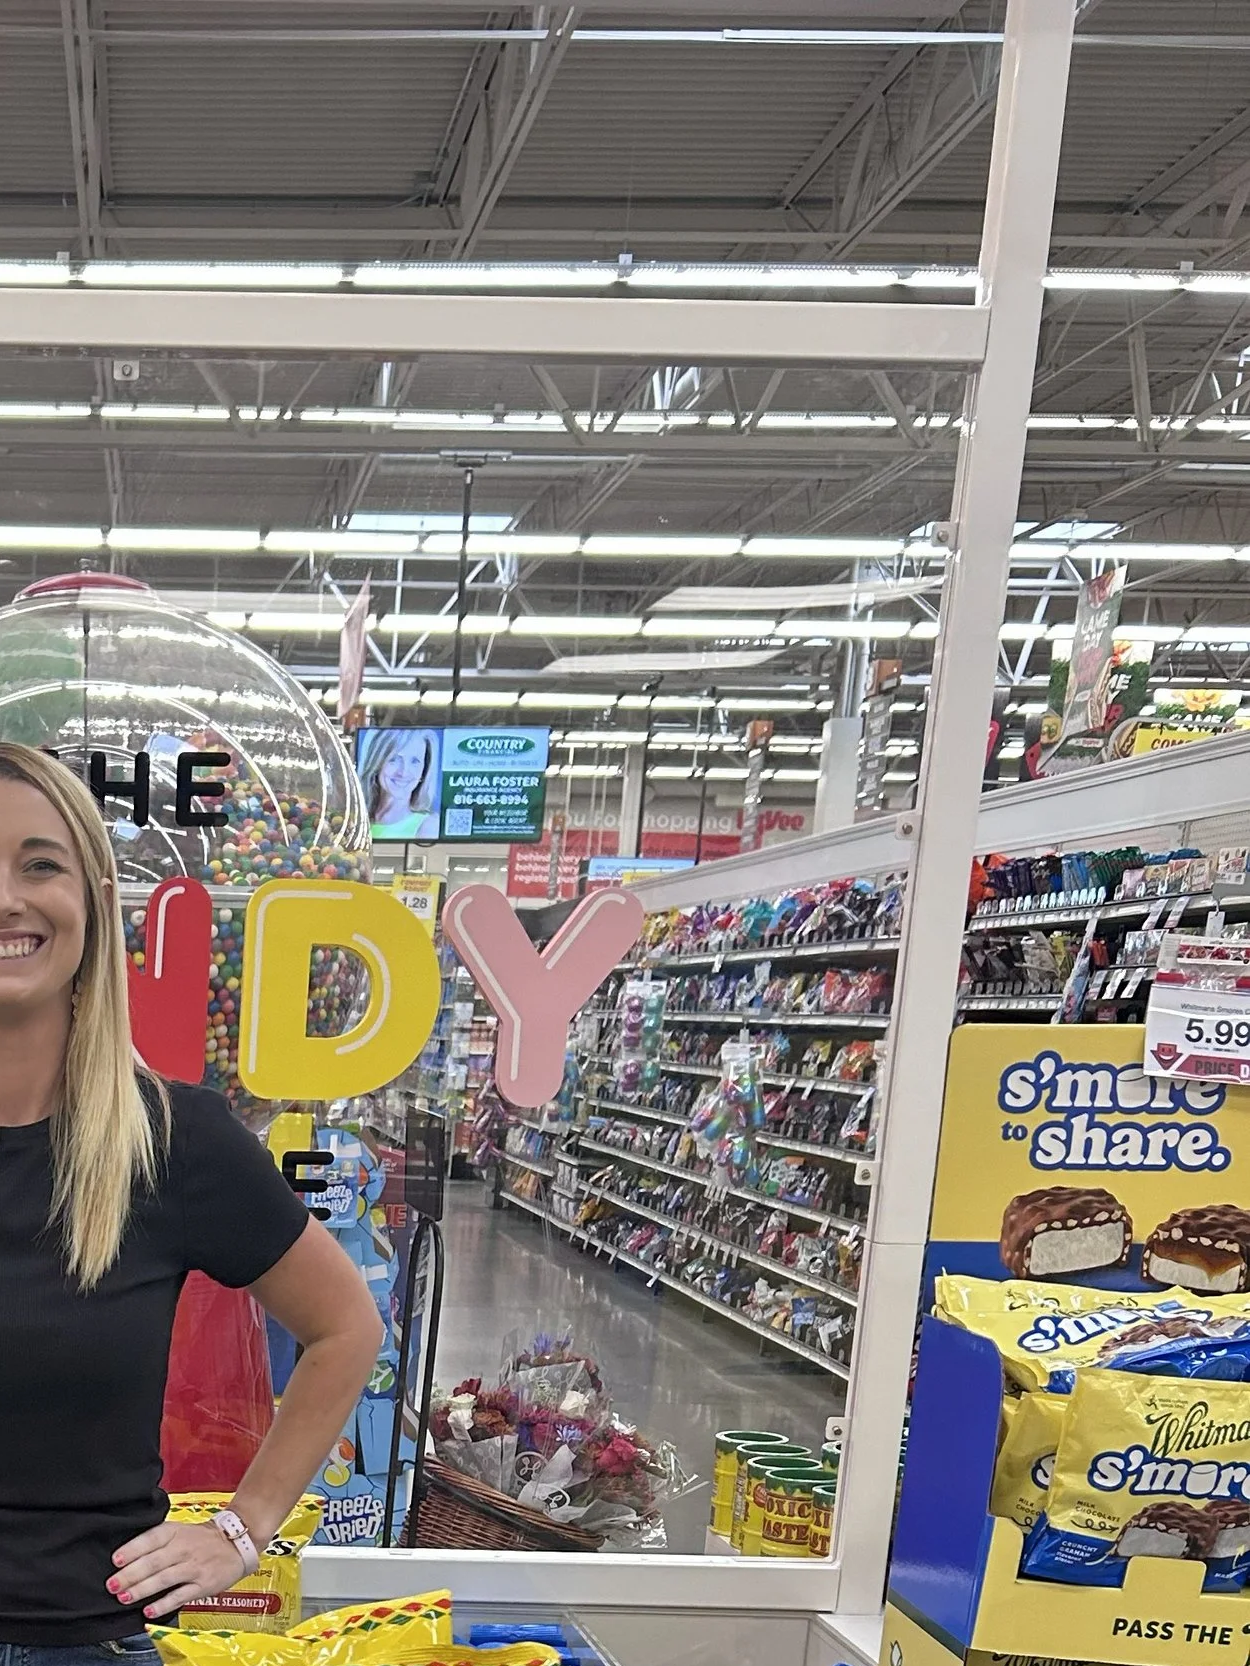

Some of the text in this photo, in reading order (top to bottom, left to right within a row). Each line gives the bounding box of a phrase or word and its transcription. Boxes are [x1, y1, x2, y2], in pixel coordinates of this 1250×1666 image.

[467, 739, 526, 749] COUNTRY
[449, 776, 539, 787] LAURA FOSTER
[90, 751, 231, 828] HE
[642, 811, 733, 833] hopping
[1184, 1018, 1250, 1048] 5.99
[1194, 1060, 1235, 1075] PRICE
[1001, 1110, 1227, 1167] to share.
[1015, 1504, 1041, 1516] CHOCO
[1076, 1500, 1095, 1509] MILK
[1061, 1541, 1098, 1552] CRUNCHY
[221, 1596, 265, 1608] SEASONED
[1112, 1618, 1234, 1645] PASS THE
